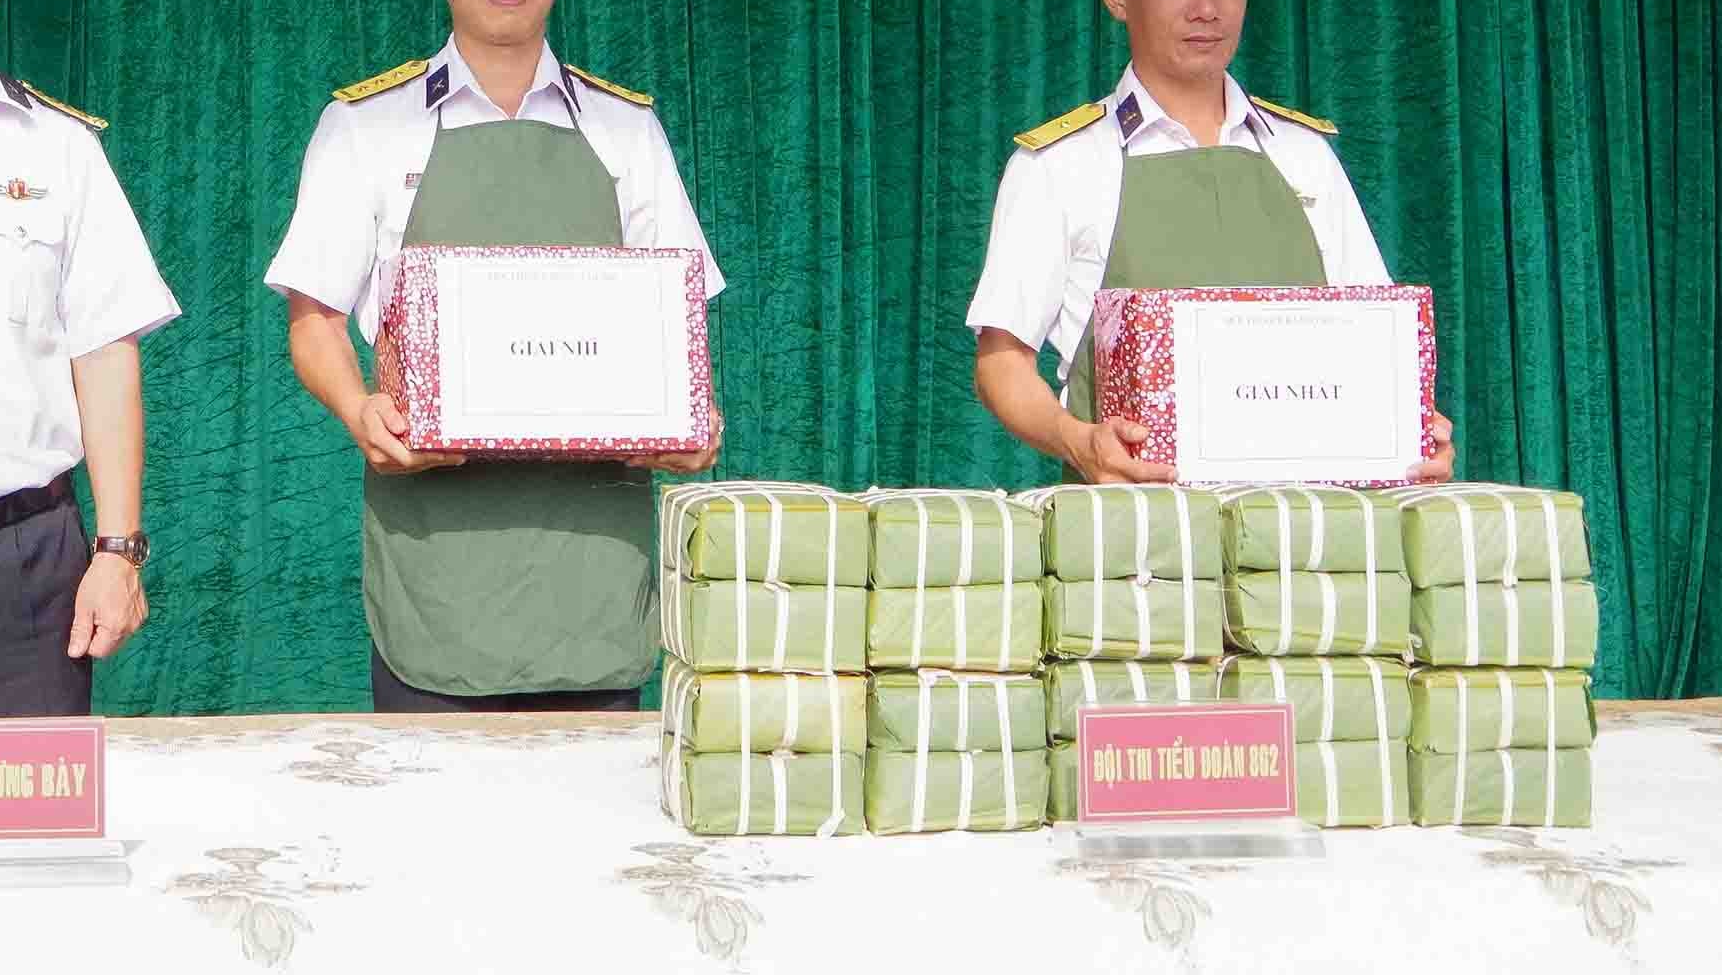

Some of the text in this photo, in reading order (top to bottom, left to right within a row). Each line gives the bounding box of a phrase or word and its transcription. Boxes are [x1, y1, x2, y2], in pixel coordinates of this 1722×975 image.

[41, 756, 86, 798] BÀY
[1126, 748, 1153, 781] THI
[1157, 736, 1195, 780] TIỂU
